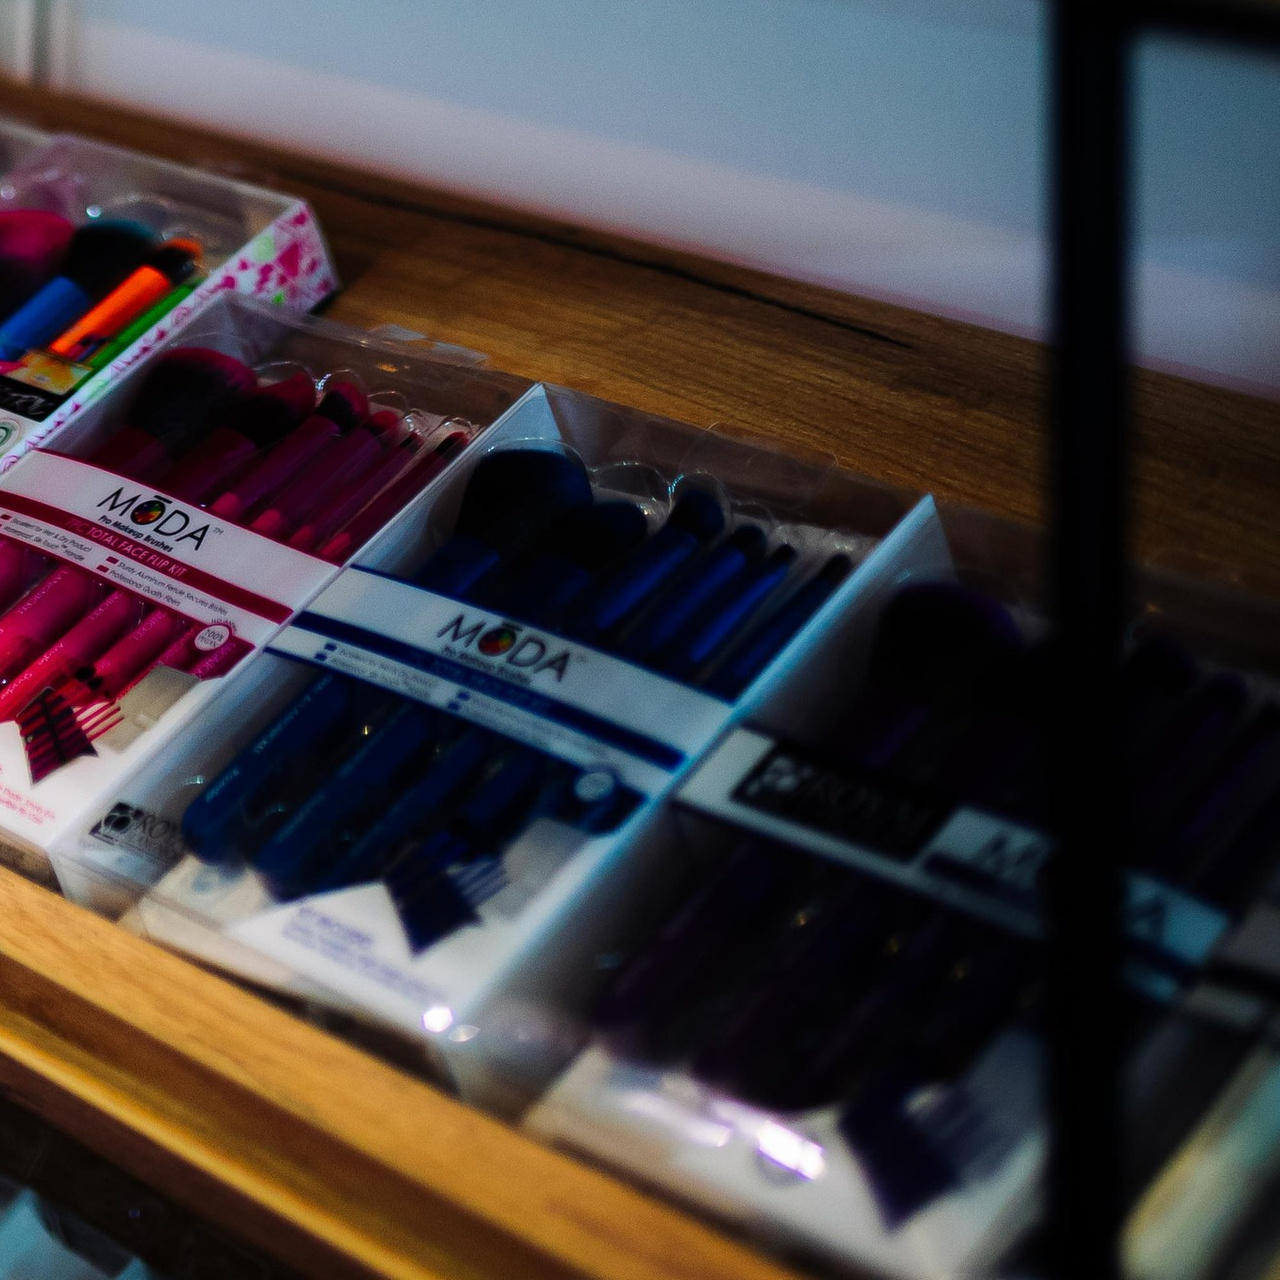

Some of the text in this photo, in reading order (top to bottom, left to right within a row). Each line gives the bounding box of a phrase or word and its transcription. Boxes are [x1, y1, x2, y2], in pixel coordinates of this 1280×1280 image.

[87, 524, 119, 547] TOTAL
[119, 540, 147, 560] FACE
[145, 553, 170, 571] FLIP
[168, 561, 188, 577] KIT
[98, 514, 175, 554] Pro Makeup Brushes
[136, 569, 167, 588] Aluminum
